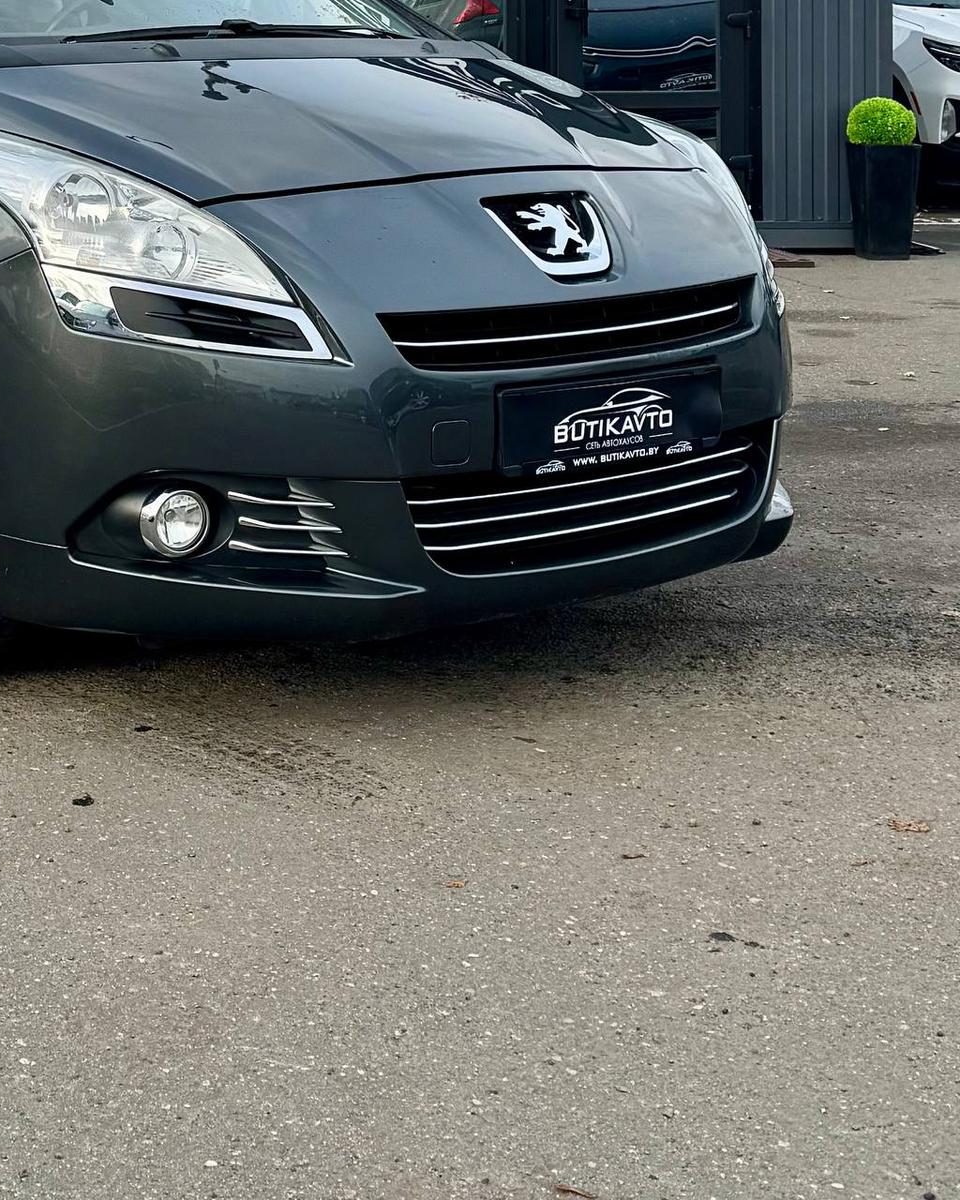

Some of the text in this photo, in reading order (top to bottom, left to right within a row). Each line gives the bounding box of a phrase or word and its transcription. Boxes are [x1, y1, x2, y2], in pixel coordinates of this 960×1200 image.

[553, 409, 673, 444] BUTIKAVTO
[585, 441, 601, 450] СЕТЬ
[573, 446, 660, 467] WWW. BUTIKAVTO.BY
